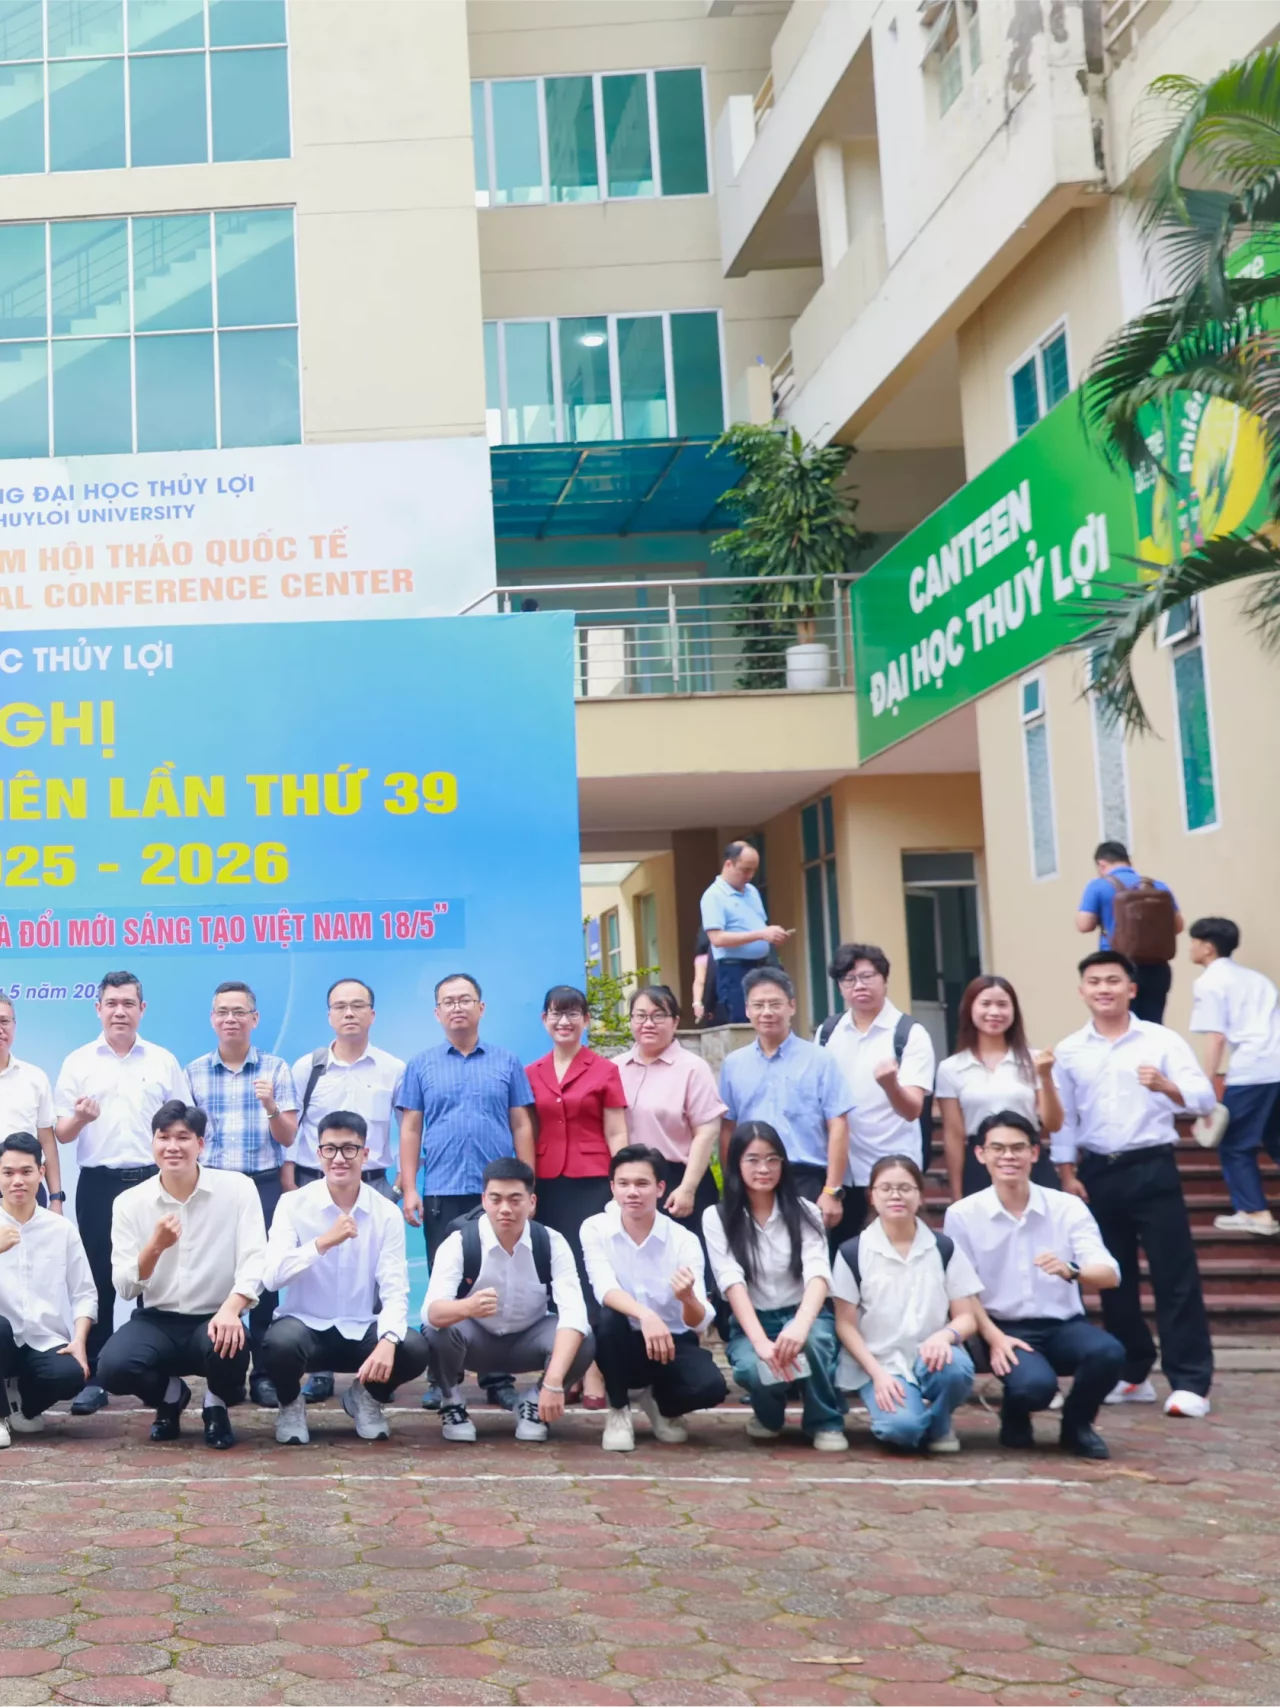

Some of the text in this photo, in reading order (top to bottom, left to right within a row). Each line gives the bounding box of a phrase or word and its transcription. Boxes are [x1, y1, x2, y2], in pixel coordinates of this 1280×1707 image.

[33, 485, 75, 507] ĐẠI
[84, 481, 139, 504] HỌC
[147, 473, 208, 497] THỦY
[216, 474, 255, 498] LỢI
[78, 504, 195, 524] UNIVERSITY
[39, 541, 94, 576] HỘI
[106, 534, 193, 569] THẢO
[205, 528, 297, 567] QUỐC
[308, 525, 348, 560] TẾ
[909, 479, 1032, 614] CANTEEN
[44, 574, 268, 608] CONFERENCE
[280, 568, 414, 598] CENTER
[870, 652, 909, 718] ĐẠI
[912, 616, 966, 690] HỌC
[1051, 512, 1110, 602] LỢI
[33, 638, 114, 673] THỦY
[123, 642, 173, 677] LỢI
[108, 761, 226, 820] LẦN
[246, 763, 369, 816] THỨ
[384, 771, 459, 814] 39
[98, 862, 119, 873] -
[141, 841, 290, 886] 2026
[19, 909, 60, 948] ĐỔI
[68, 913, 116, 947] MỚI
[123, 911, 192, 946] SÁNG
[198, 914, 245, 951] TẠO
[253, 907, 306, 949] VIỆT
[313, 911, 372, 941] NAM
[10, 984, 21, 999] 5
[26, 983, 67, 999] năm
